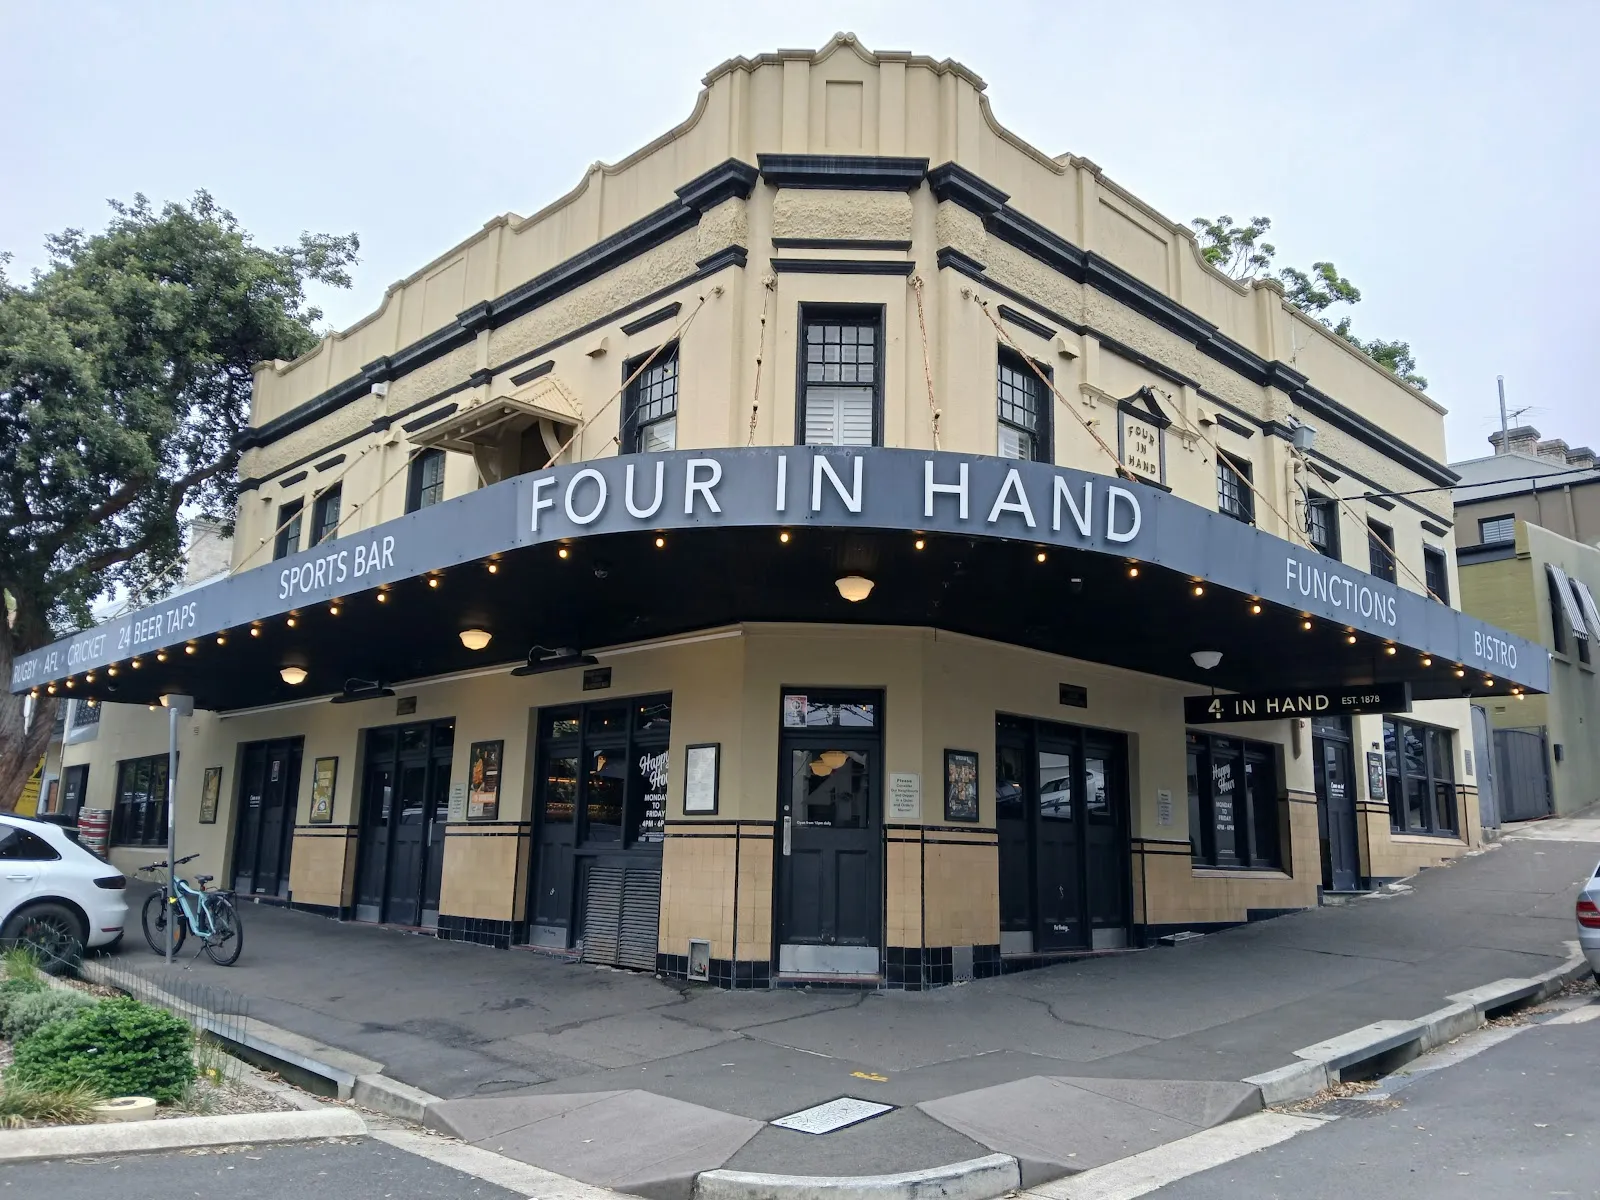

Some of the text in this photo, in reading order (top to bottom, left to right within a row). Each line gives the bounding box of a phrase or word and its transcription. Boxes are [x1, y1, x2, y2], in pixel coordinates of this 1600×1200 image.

[1128, 426, 1155, 446] FOUR
[1136, 442, 1147, 454] IN
[1128, 455, 1156, 474] HAND
[530, 455, 1142, 543] FOUR IN HAND
[279, 535, 395, 600] SPORTS BAR
[1286, 558, 1397, 627] FUNCTIONS
[118, 602, 197, 650] 24 BEER TAPS
[13, 634, 107, 684] RUGBY AFL CRICKET
[1474, 631, 1518, 669] BISTRO
[1208, 695, 1380, 719] 4 IN HAND EST. 1878
[1212, 763, 1230, 780] Happy
[1217, 777, 1235, 794] Hour
[644, 793, 667, 802] MONDAY
[646, 810, 665, 818] FRIDAY
